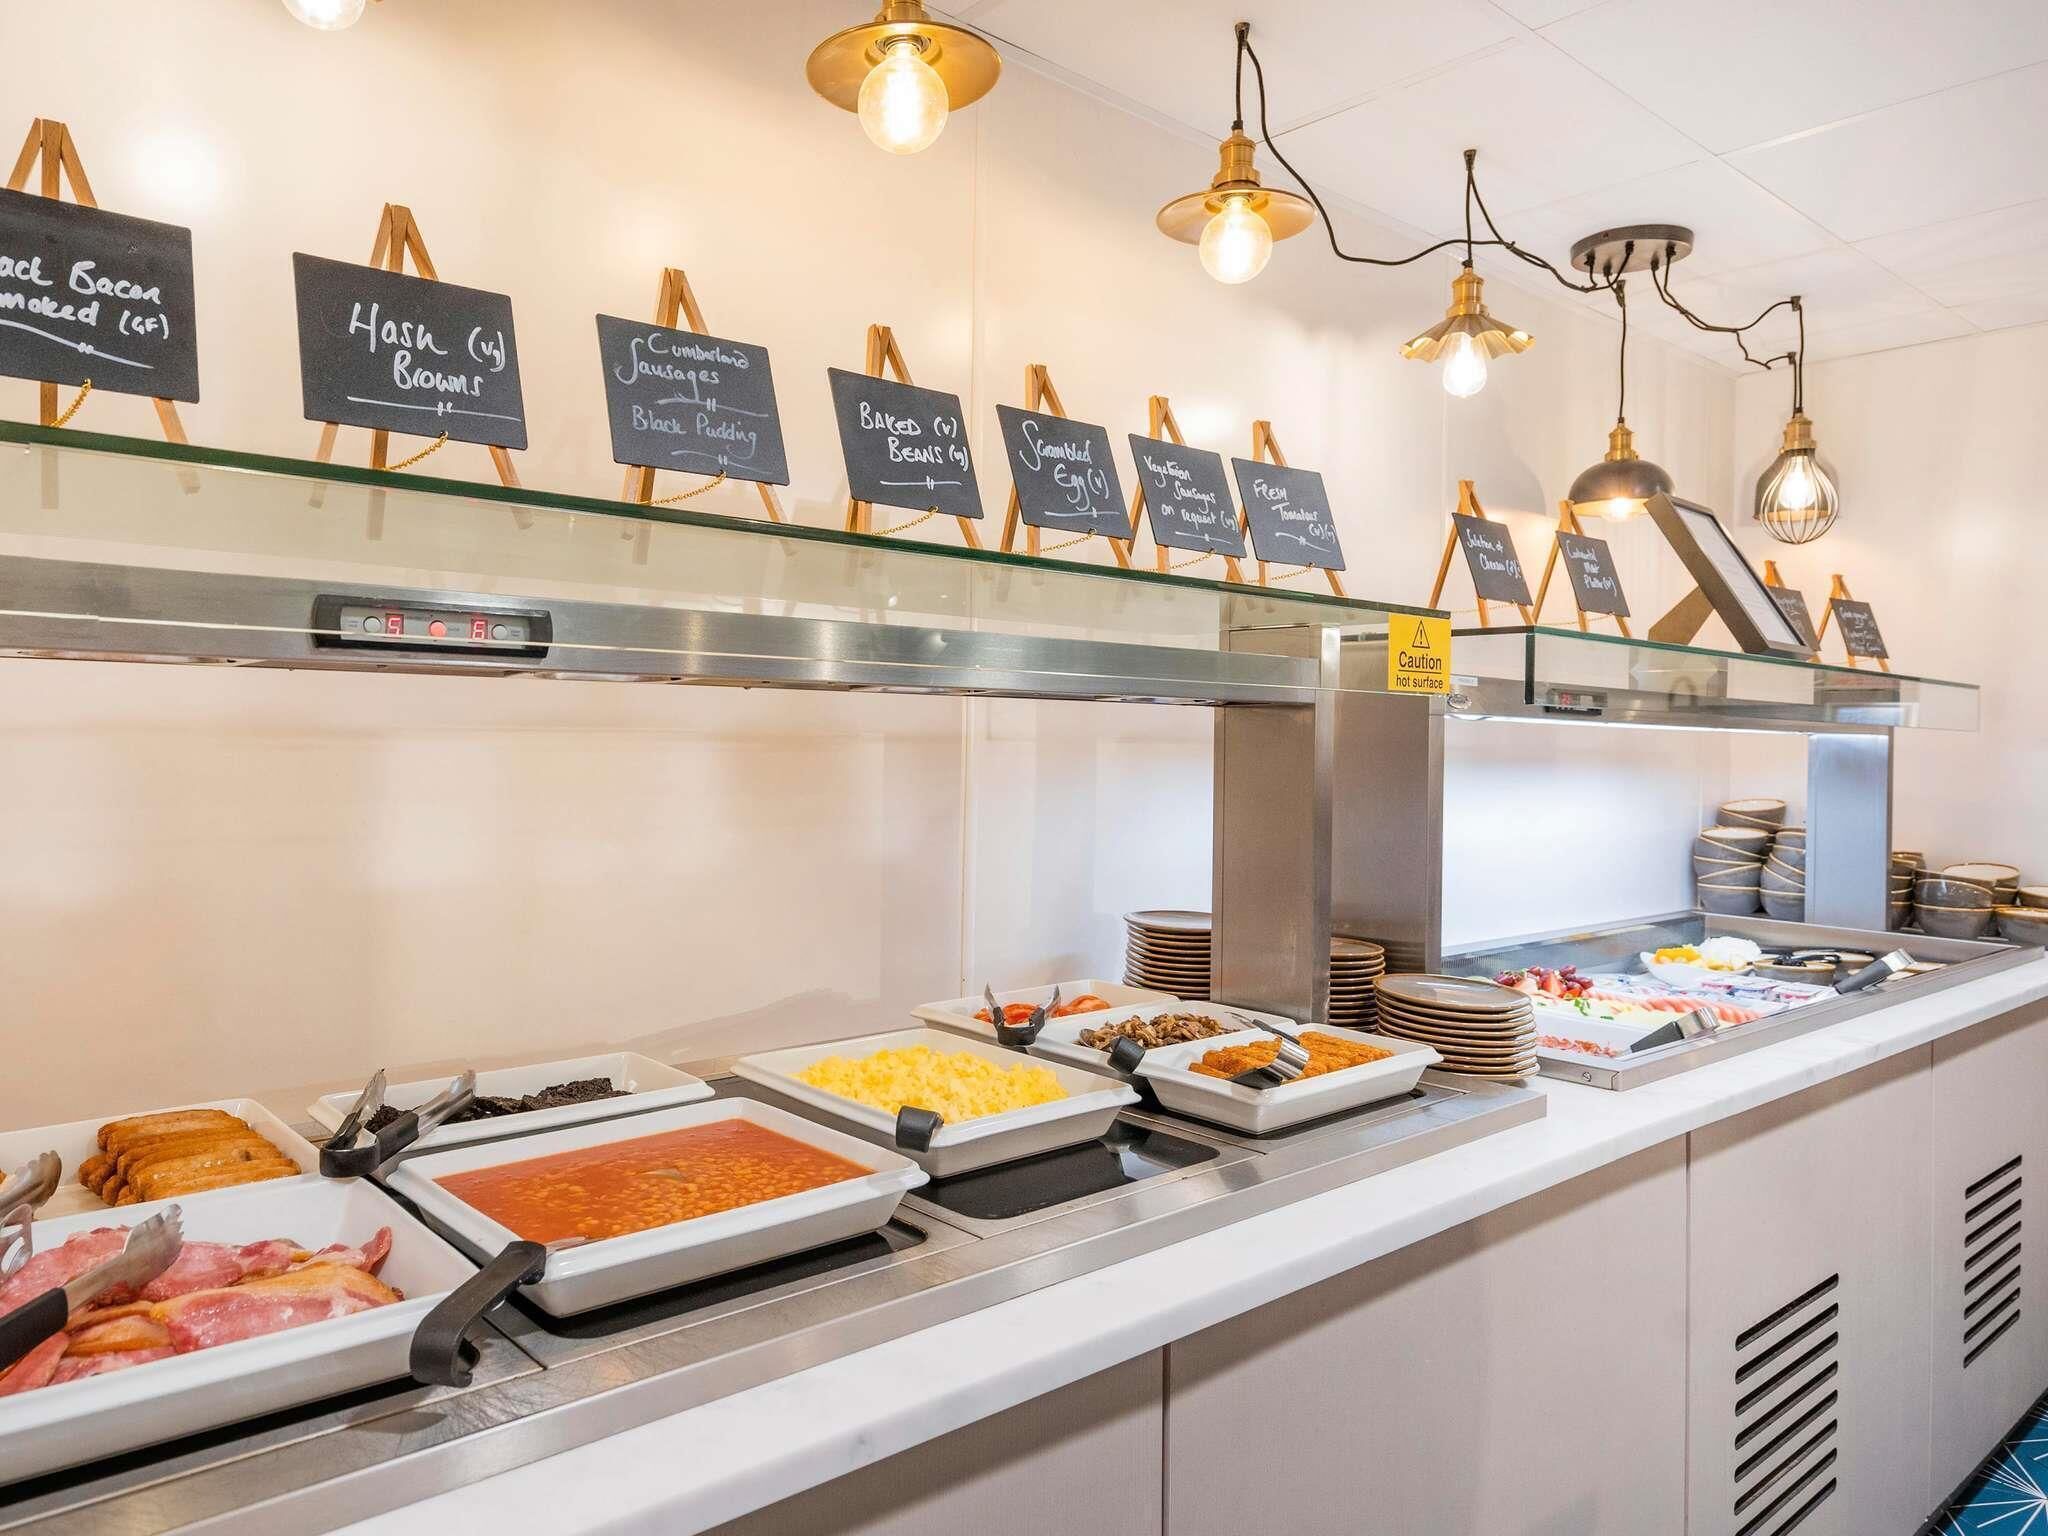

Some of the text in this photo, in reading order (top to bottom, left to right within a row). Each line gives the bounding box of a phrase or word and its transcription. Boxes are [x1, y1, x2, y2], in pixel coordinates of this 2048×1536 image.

[69, 261, 161, 305] Bacon
[349, 302, 449, 355] Hash
[614, 337, 720, 400] Sausages
[647, 332, 750, 369] Cumberland
[393, 349, 484, 397] Browns
[632, 405, 757, 459] Black Pudding
[859, 401, 921, 436] BAKED
[887, 436, 943, 463] BEANS
[1161, 504, 1175, 516] on
[1399, 651, 1442, 670] Caution
[1396, 674, 1410, 687] hot
[1413, 676, 1443, 689] surface
